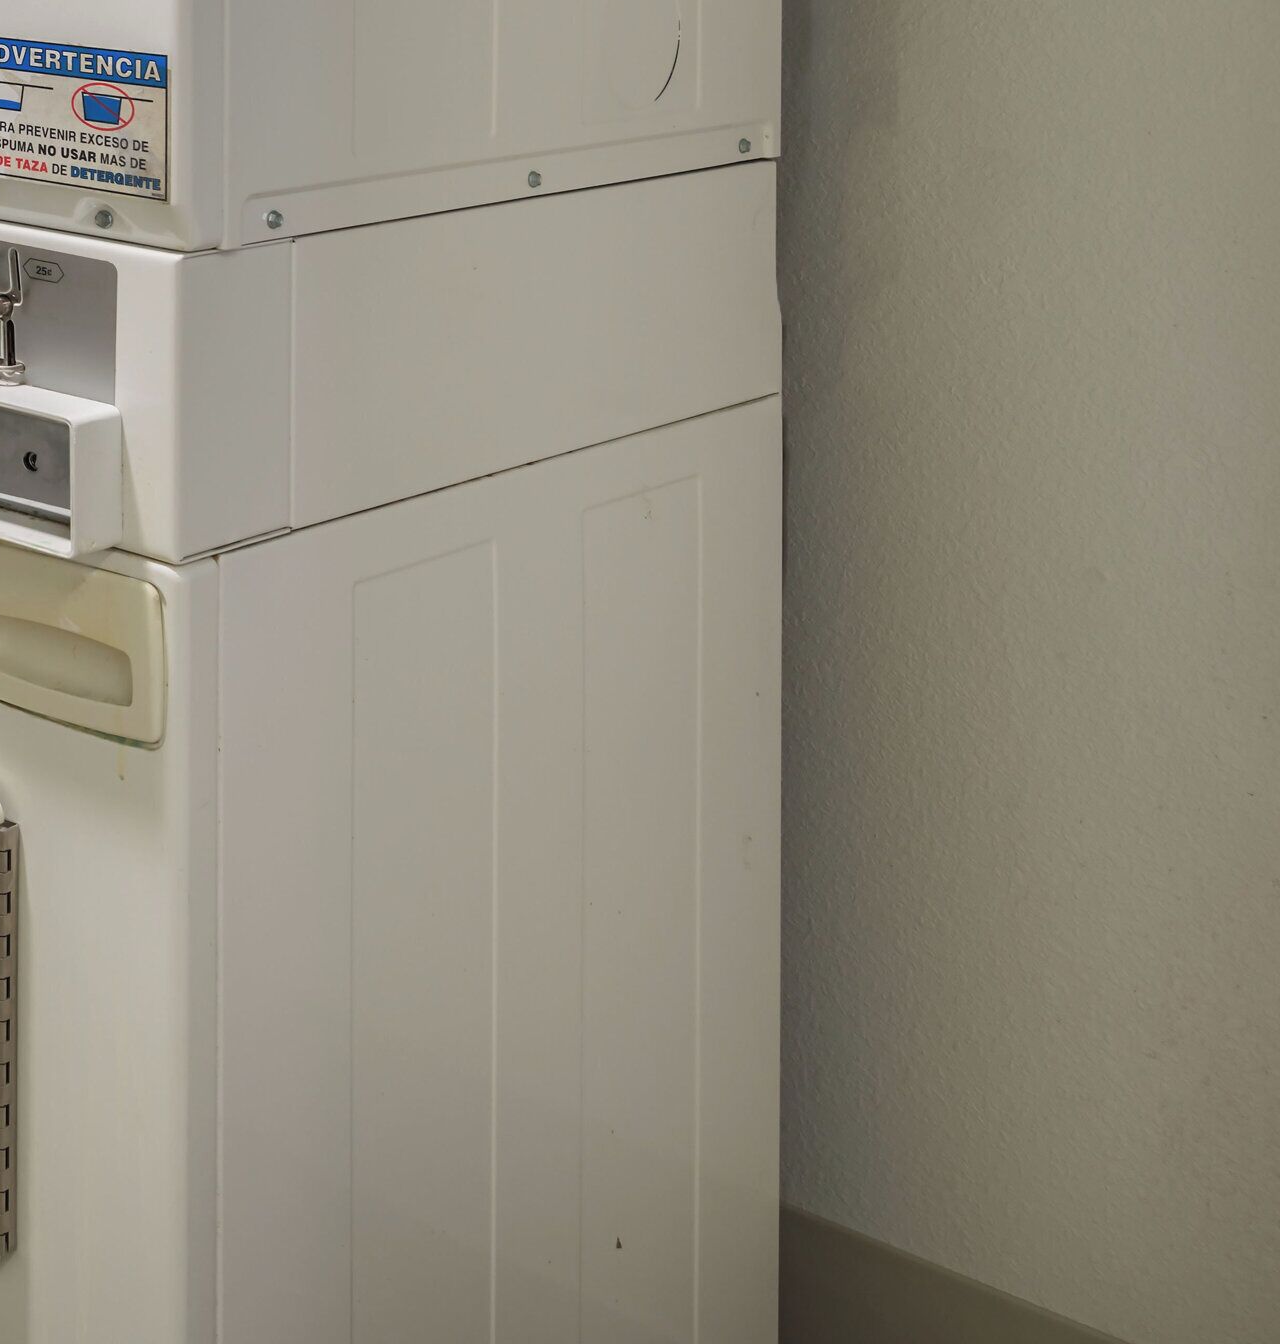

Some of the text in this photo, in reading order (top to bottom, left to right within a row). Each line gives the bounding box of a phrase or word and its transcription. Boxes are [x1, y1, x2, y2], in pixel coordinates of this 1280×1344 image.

[19, 123, 76, 142] PREVENIR
[80, 132, 128, 150] EXCESO
[132, 139, 149, 153] DE
[38, 144, 56, 157] NO
[61, 147, 97, 163] USAR
[100, 153, 126, 167] MAS
[130, 157, 146, 170] DE
[16, 157, 48, 173] TAZA
[52, 163, 67, 176] DE
[70, 165, 161, 191] DETERGENTE
